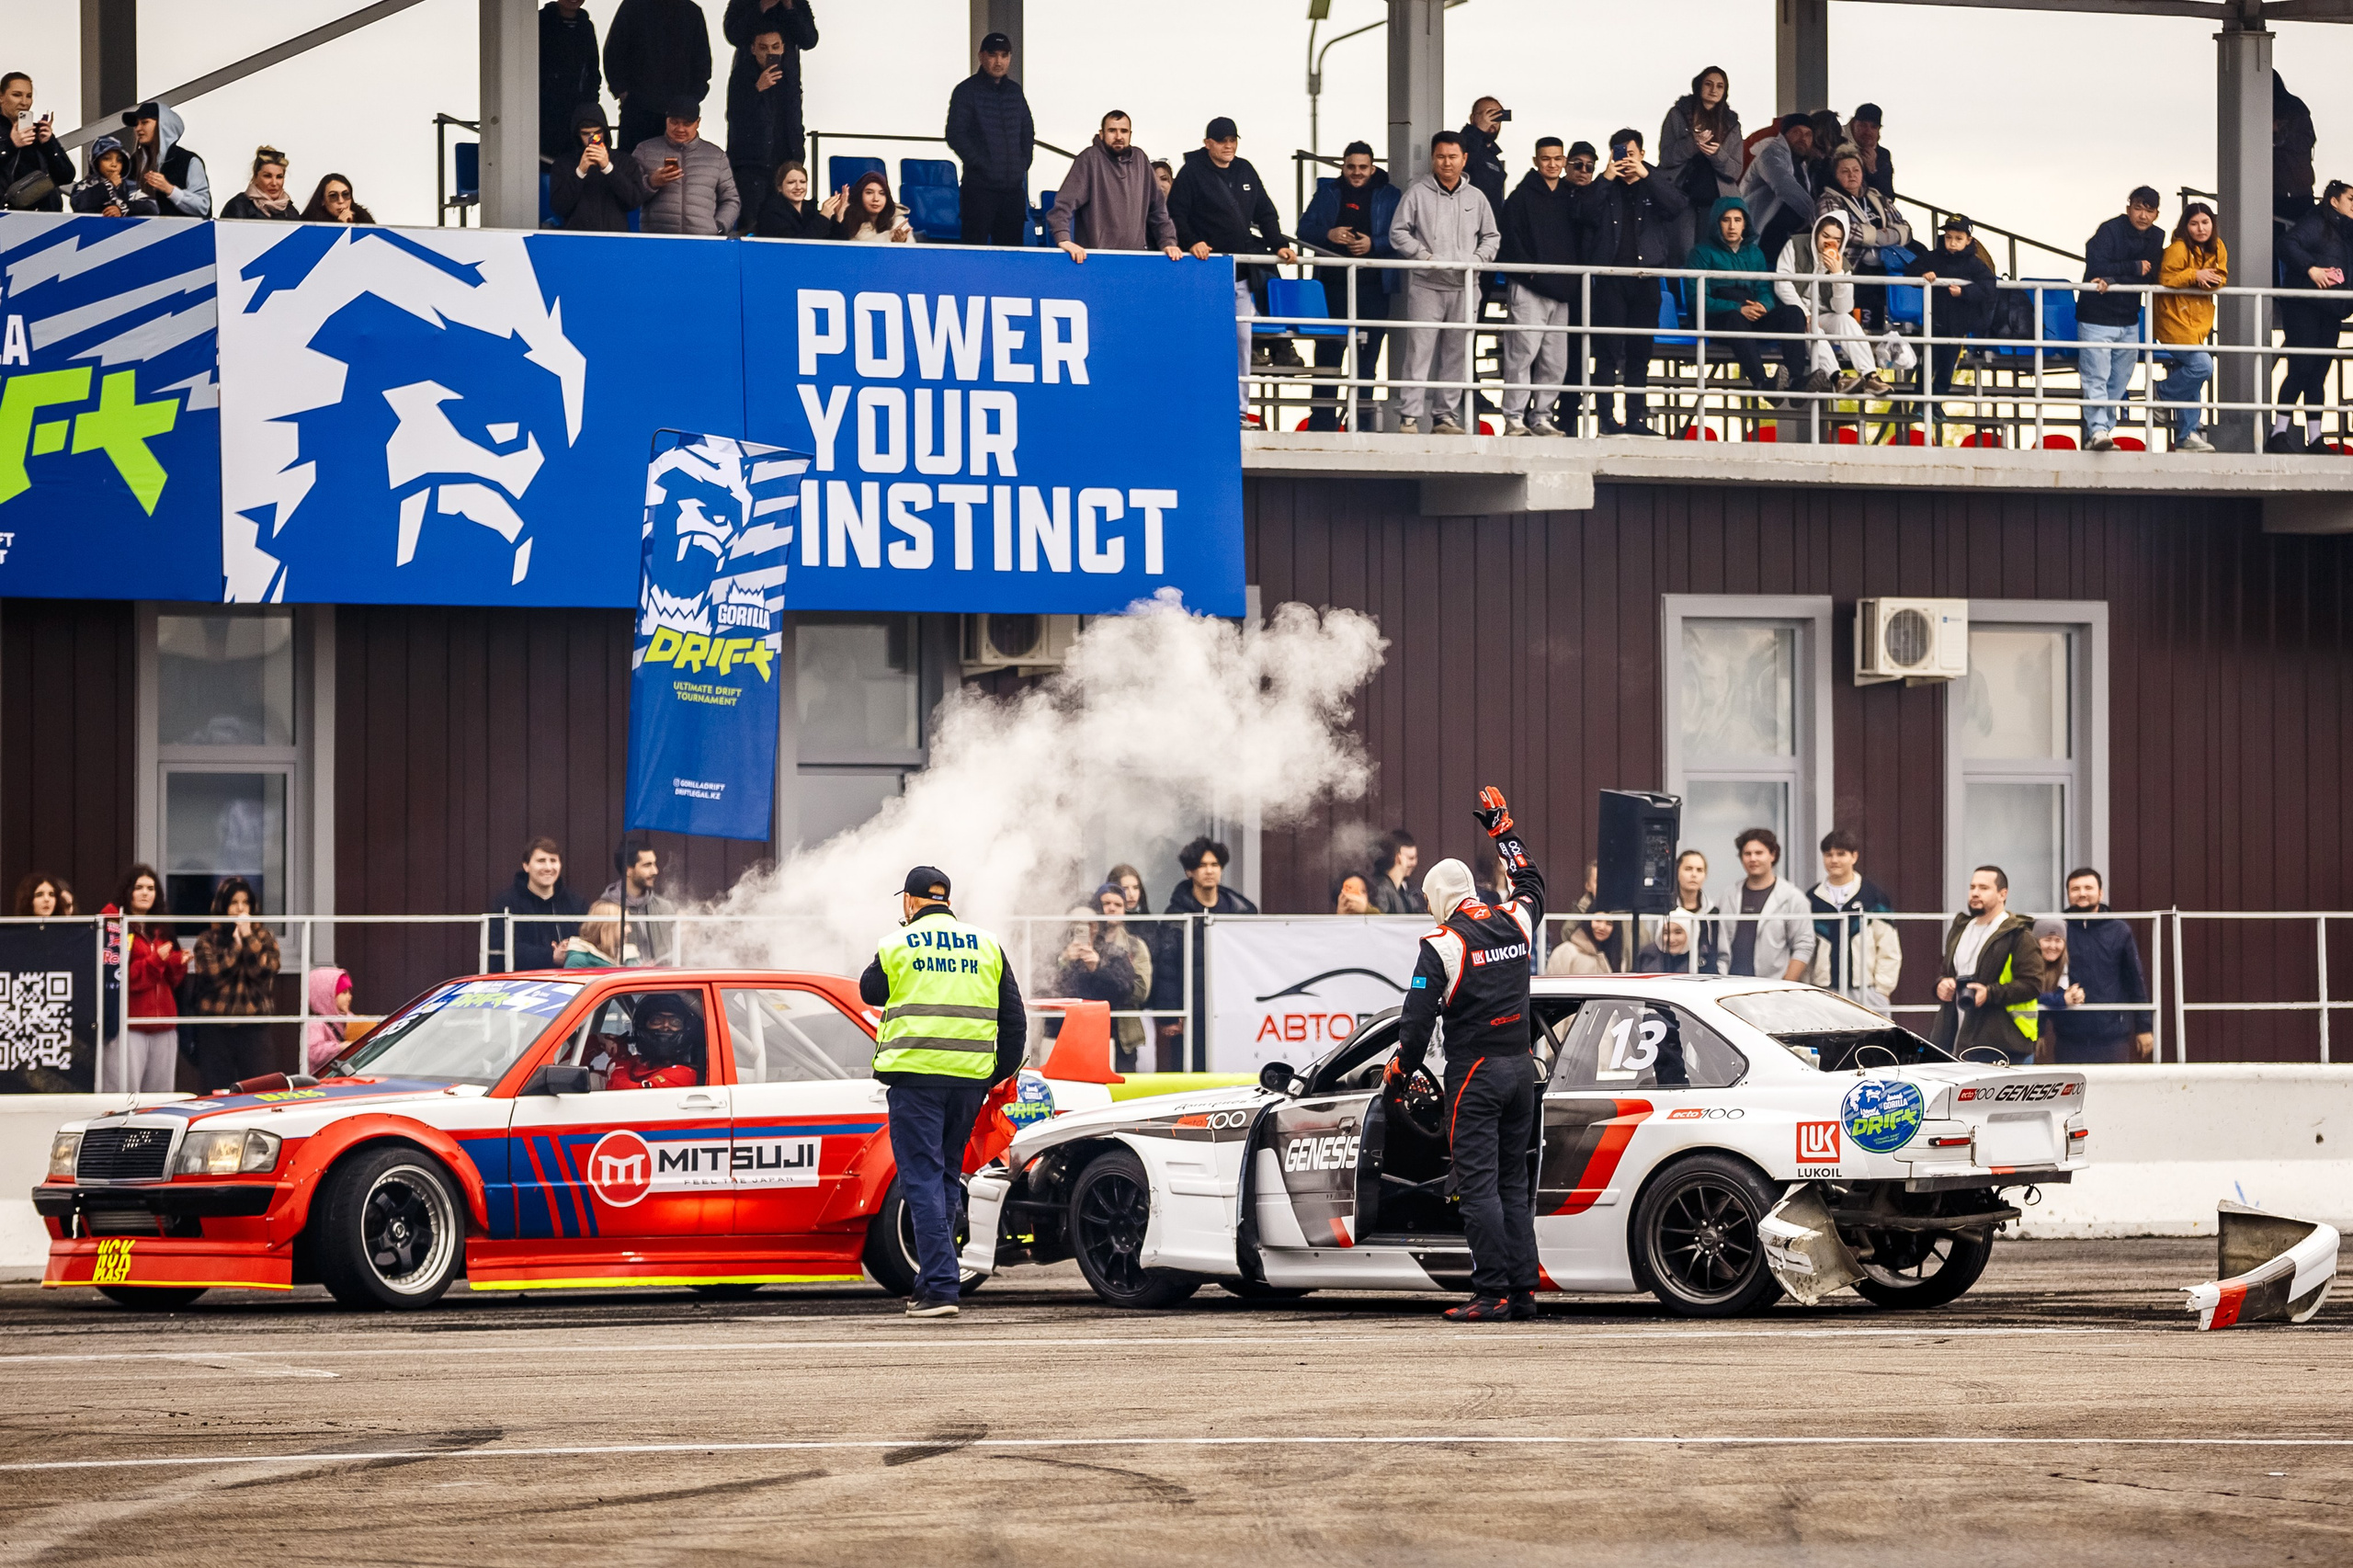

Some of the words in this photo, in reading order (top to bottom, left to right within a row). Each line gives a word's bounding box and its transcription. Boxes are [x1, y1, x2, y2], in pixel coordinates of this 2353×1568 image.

[797, 289, 1090, 385] POWER
[797, 383, 1018, 477] YOUR
[799, 478, 1178, 575] INSTINCT
[717, 604, 770, 631] GORILLA
[643, 626, 775, 684] DRIFT
[673, 680, 713, 695] ULTIMATE
[714, 685, 743, 698] DRIFT
[676, 691, 737, 707] TOURNAMENT
[906, 930, 978, 951] СУДЬЯ
[1484, 942, 1527, 963] LUKOIL
[913, 957, 957, 972] ФАМС
[961, 959, 978, 974] РК
[1609, 1017, 1668, 1071] 13
[1883, 1097, 1908, 1110] GORILLA
[1995, 1082, 2064, 1102] GENESIS
[1003, 1101, 1051, 1119] DRIFT
[1851, 1108, 1917, 1137] DRIFT
[658, 1143, 814, 1173] MITSUJI
[1285, 1135, 1361, 1173] GENESIS
[1798, 1168, 1842, 1178] LUKOIL
